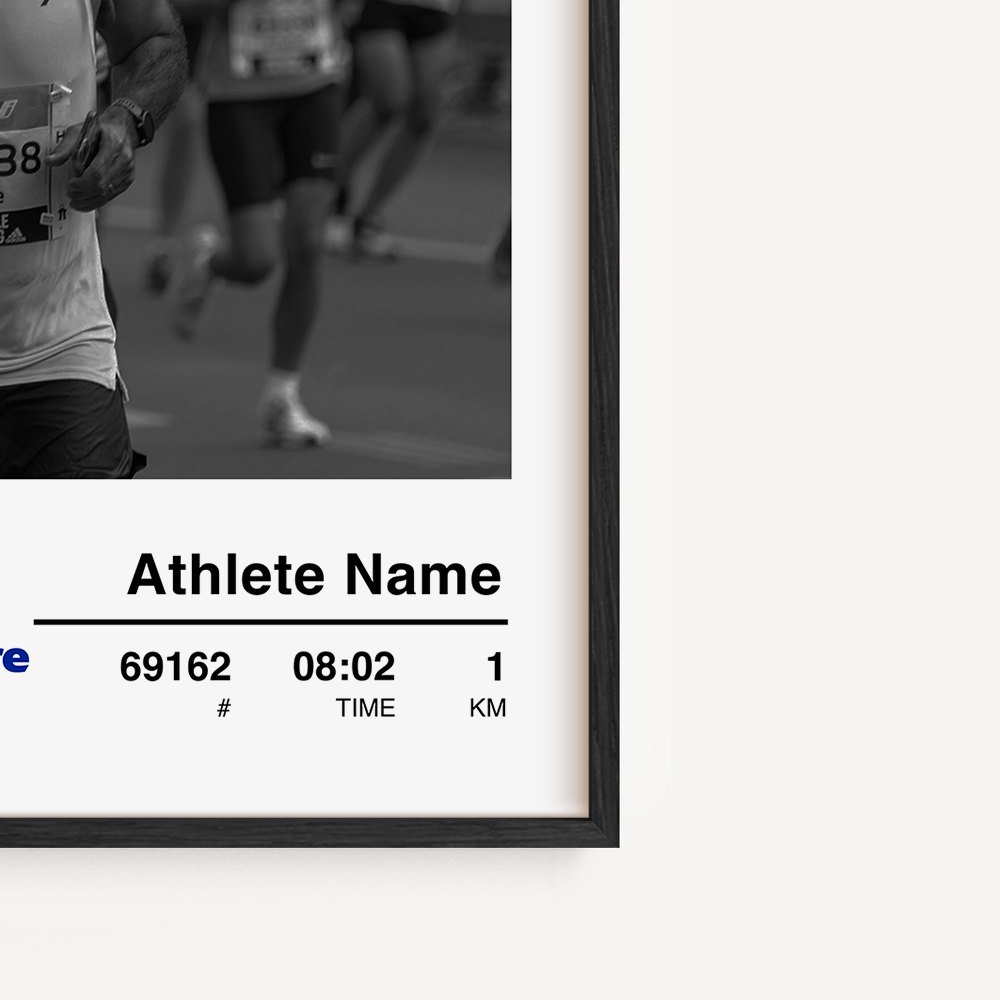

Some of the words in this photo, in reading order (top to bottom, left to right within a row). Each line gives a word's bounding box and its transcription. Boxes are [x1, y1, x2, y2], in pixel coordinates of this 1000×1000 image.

[126, 552, 325, 596] Athlete
[346, 552, 502, 596] Name
[120, 651, 231, 682] 69162
[293, 651, 395, 682] 08:02
[487, 652, 502, 681] 1
[335, 698, 396, 718] TIME
[470, 698, 506, 718] KM
